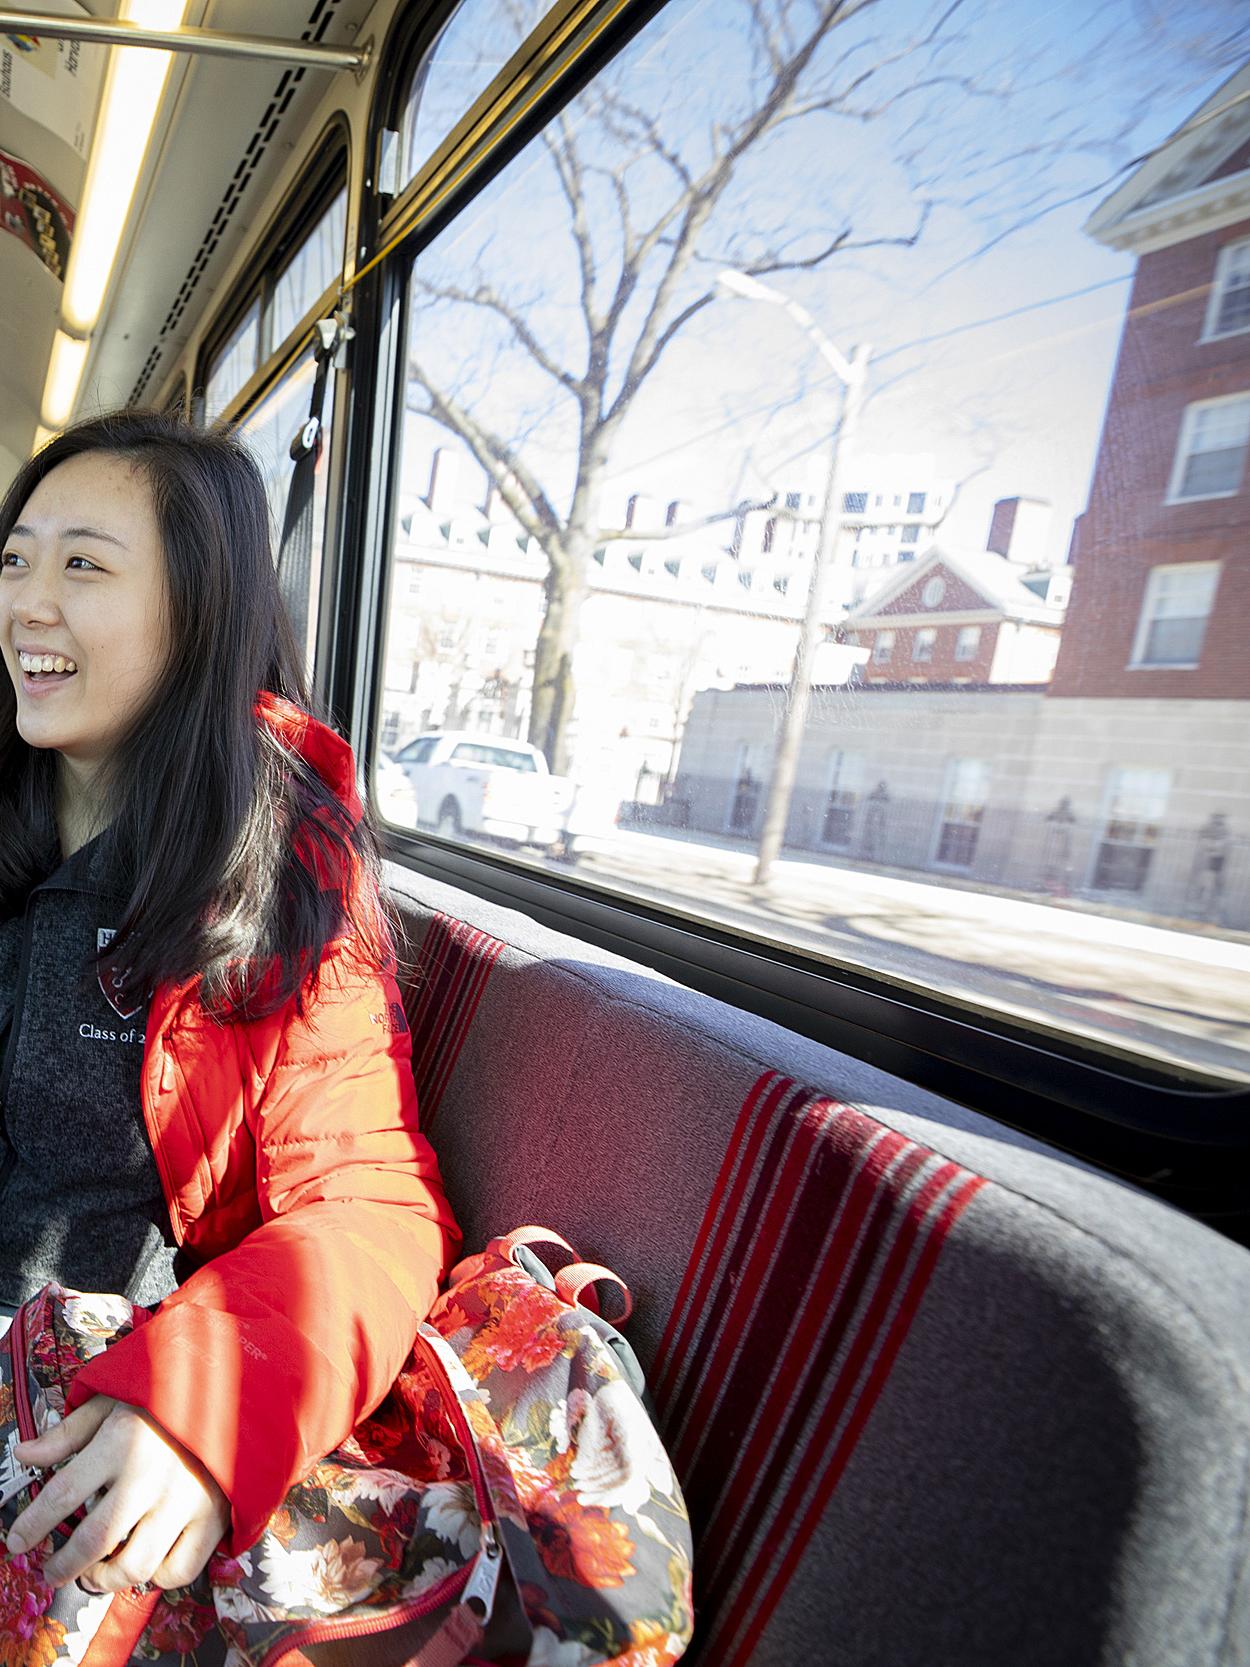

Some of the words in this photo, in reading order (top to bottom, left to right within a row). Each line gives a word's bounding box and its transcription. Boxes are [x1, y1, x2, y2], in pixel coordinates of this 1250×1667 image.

[384, 1002, 398, 1012] THE
[369, 1013, 398, 1025] NORTH
[79, 1023, 116, 1041] Class
[120, 1028, 136, 1043] of
[138, 1033, 147, 1044] 2
[382, 1023, 400, 1034] FACE
